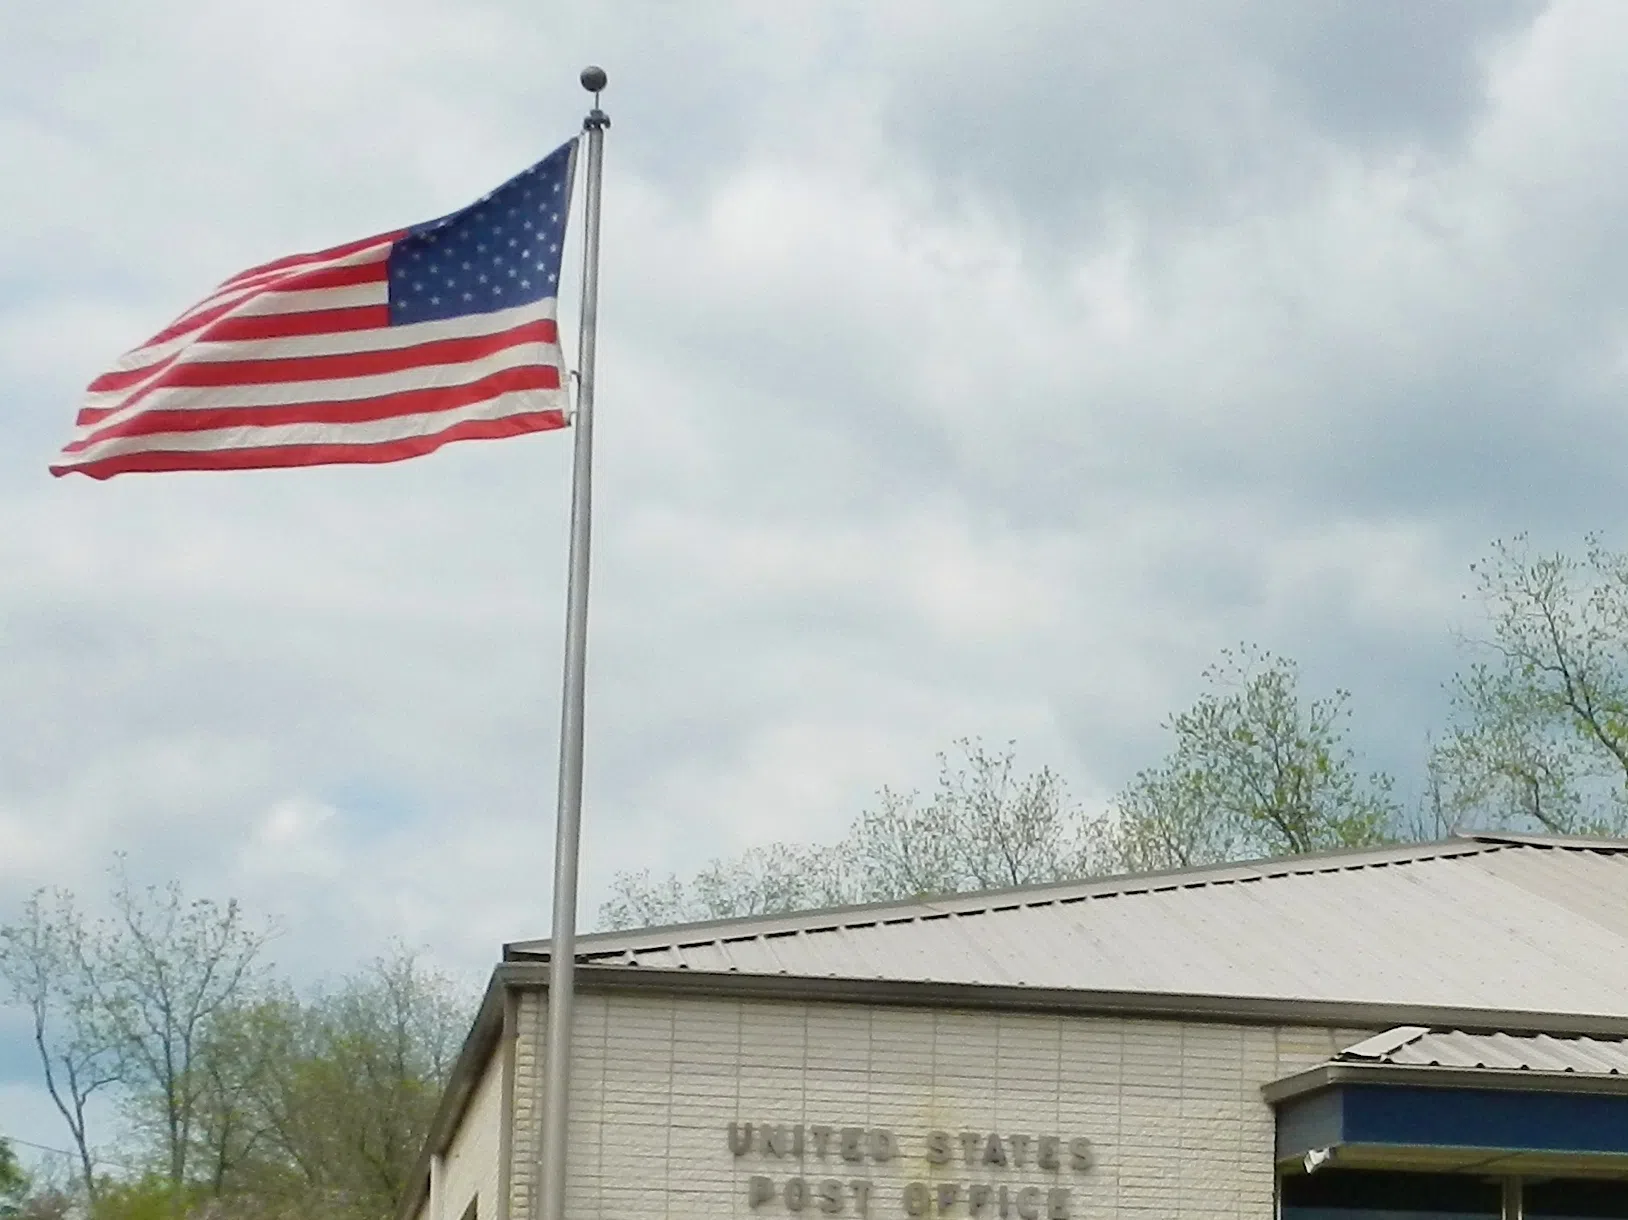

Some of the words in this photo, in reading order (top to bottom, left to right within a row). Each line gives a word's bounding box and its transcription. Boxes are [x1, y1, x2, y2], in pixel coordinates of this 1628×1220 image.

[727, 1121, 898, 1162] UNITED
[926, 1130, 1096, 1172] STATES
[748, 1175, 874, 1216] POST
